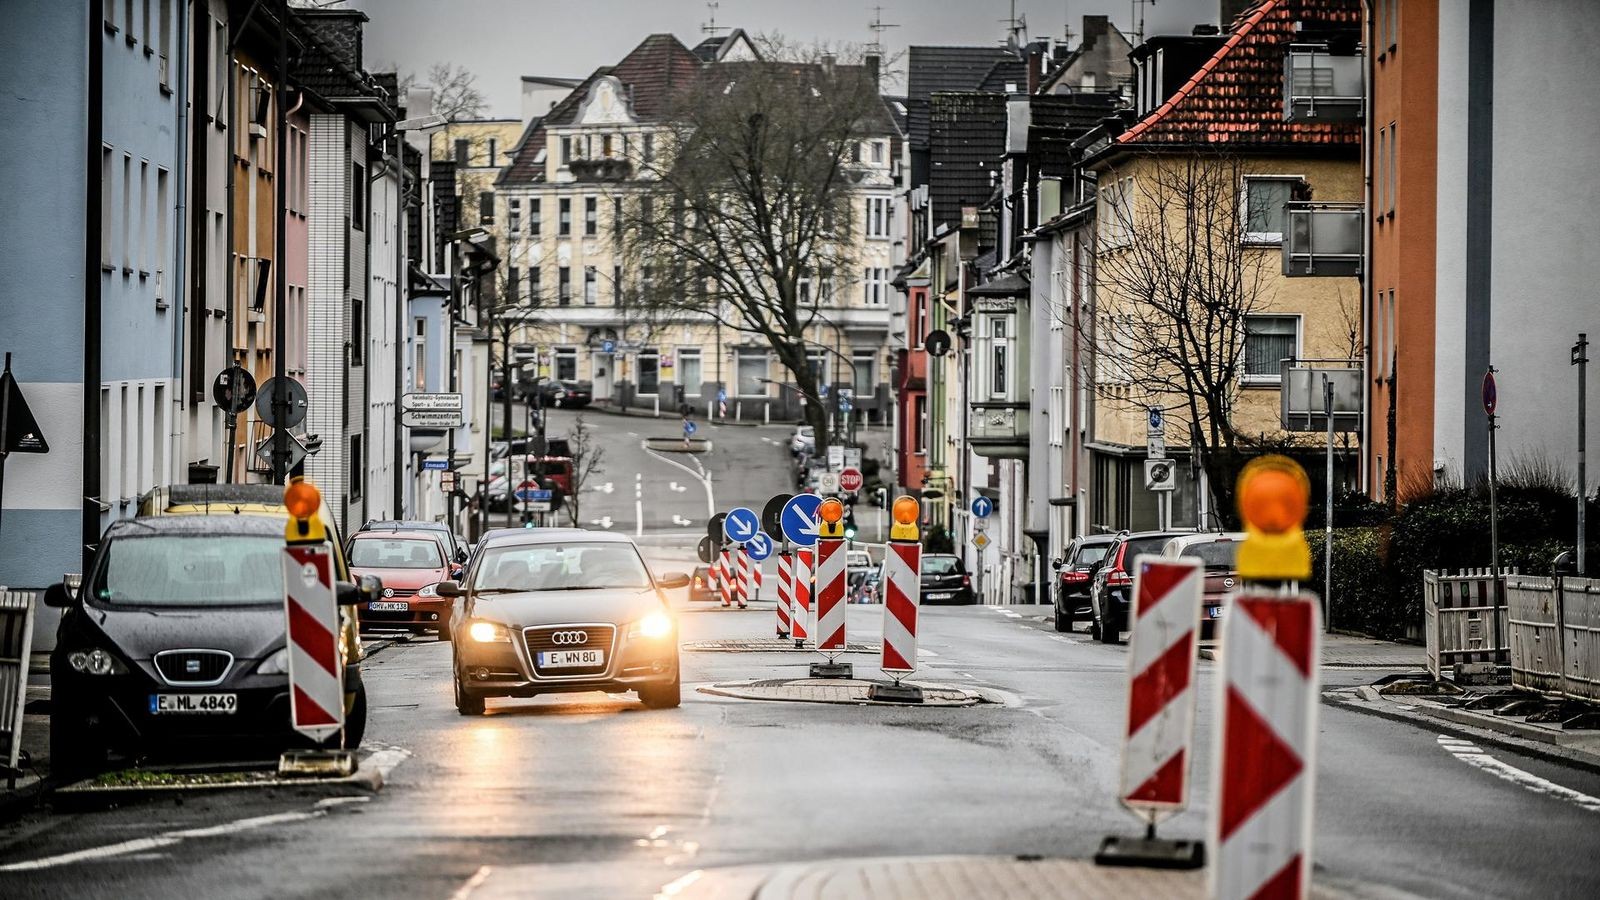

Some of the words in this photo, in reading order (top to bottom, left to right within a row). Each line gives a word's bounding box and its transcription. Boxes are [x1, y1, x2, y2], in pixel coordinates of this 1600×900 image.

[841, 474, 860, 485] STOP
[551, 653, 558, 664] E
[566, 652, 580, 663] WN
[583, 652, 596, 662] 80
[158, 695, 168, 710] E
[177, 695, 196, 710] ML
[199, 695, 236, 710] 4849
